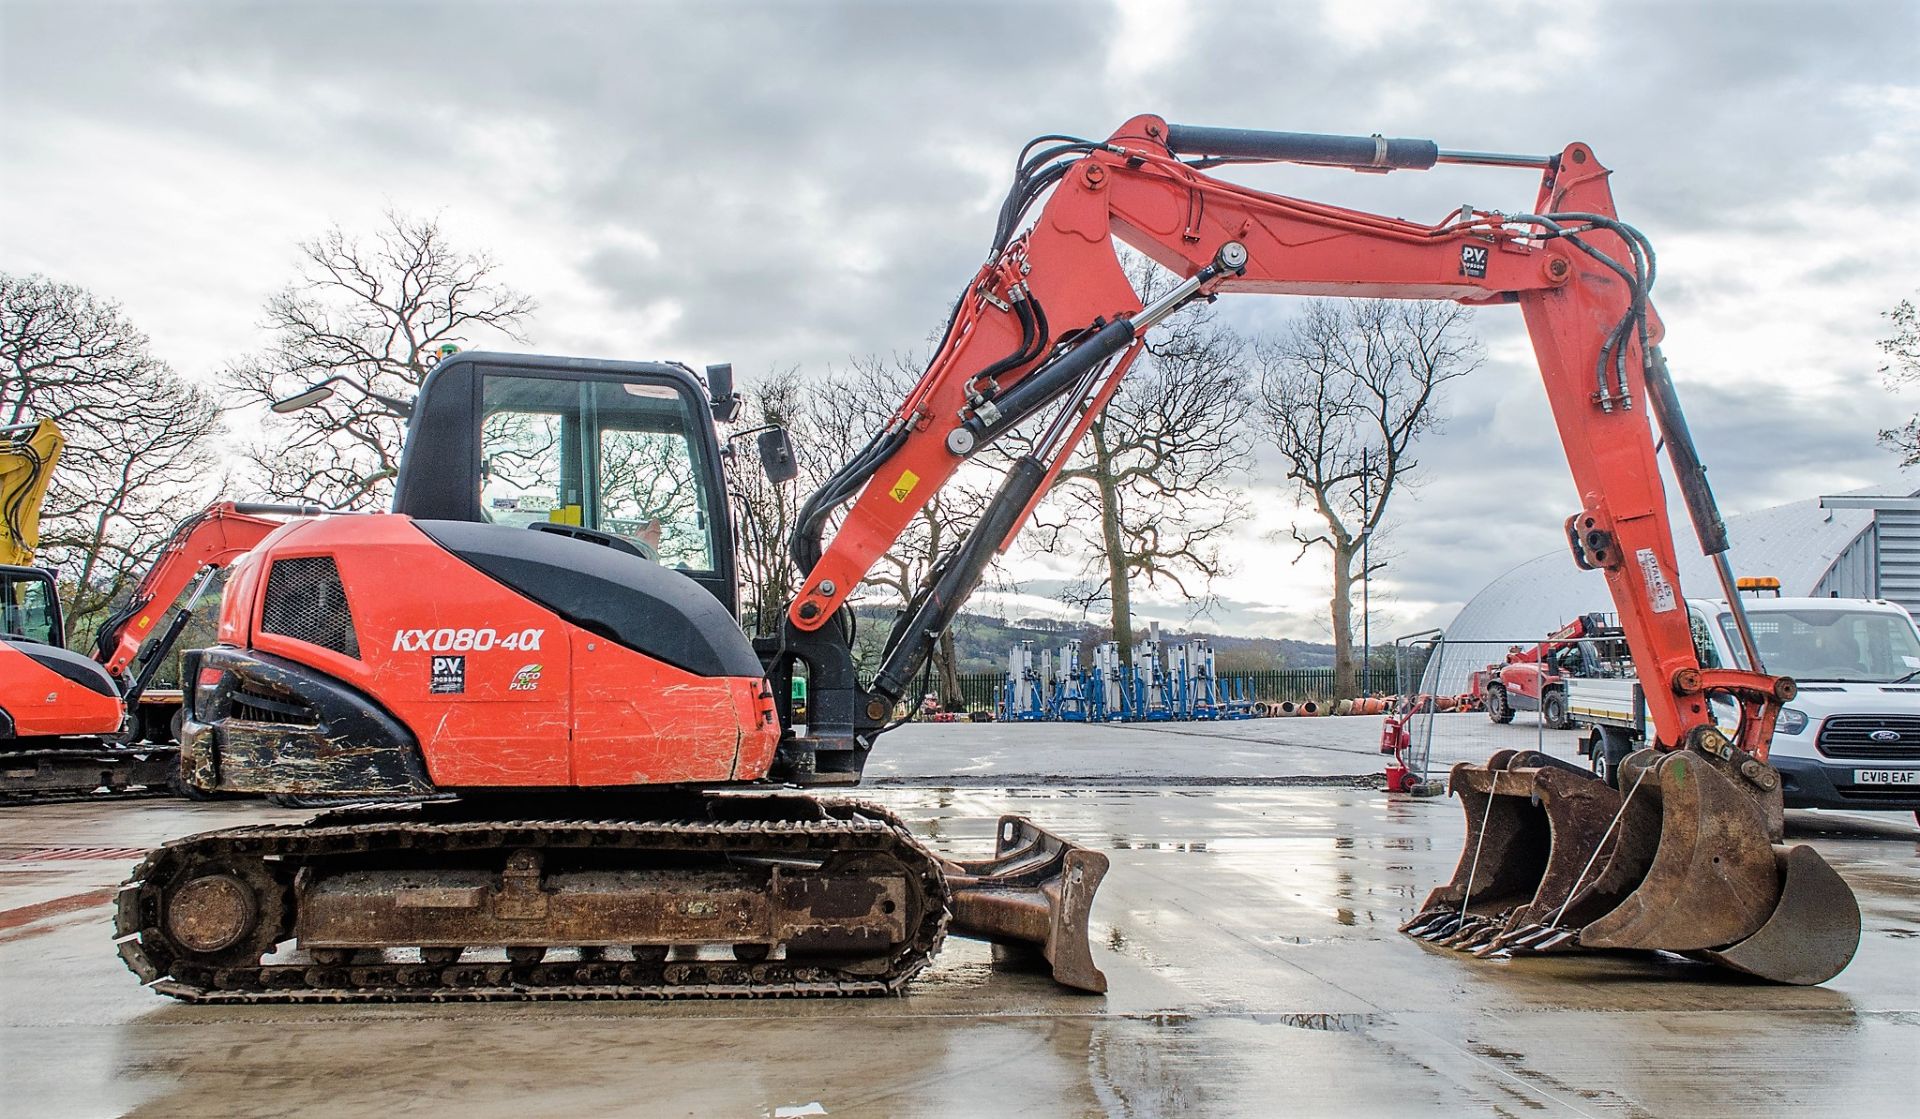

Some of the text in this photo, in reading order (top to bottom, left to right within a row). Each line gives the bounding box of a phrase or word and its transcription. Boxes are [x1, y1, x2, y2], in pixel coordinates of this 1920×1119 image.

[433, 657, 463, 675] P.V.
[518, 672, 541, 680] eco
[509, 682, 539, 690] PLUS
[1861, 771, 1915, 783] CV18 EAF
